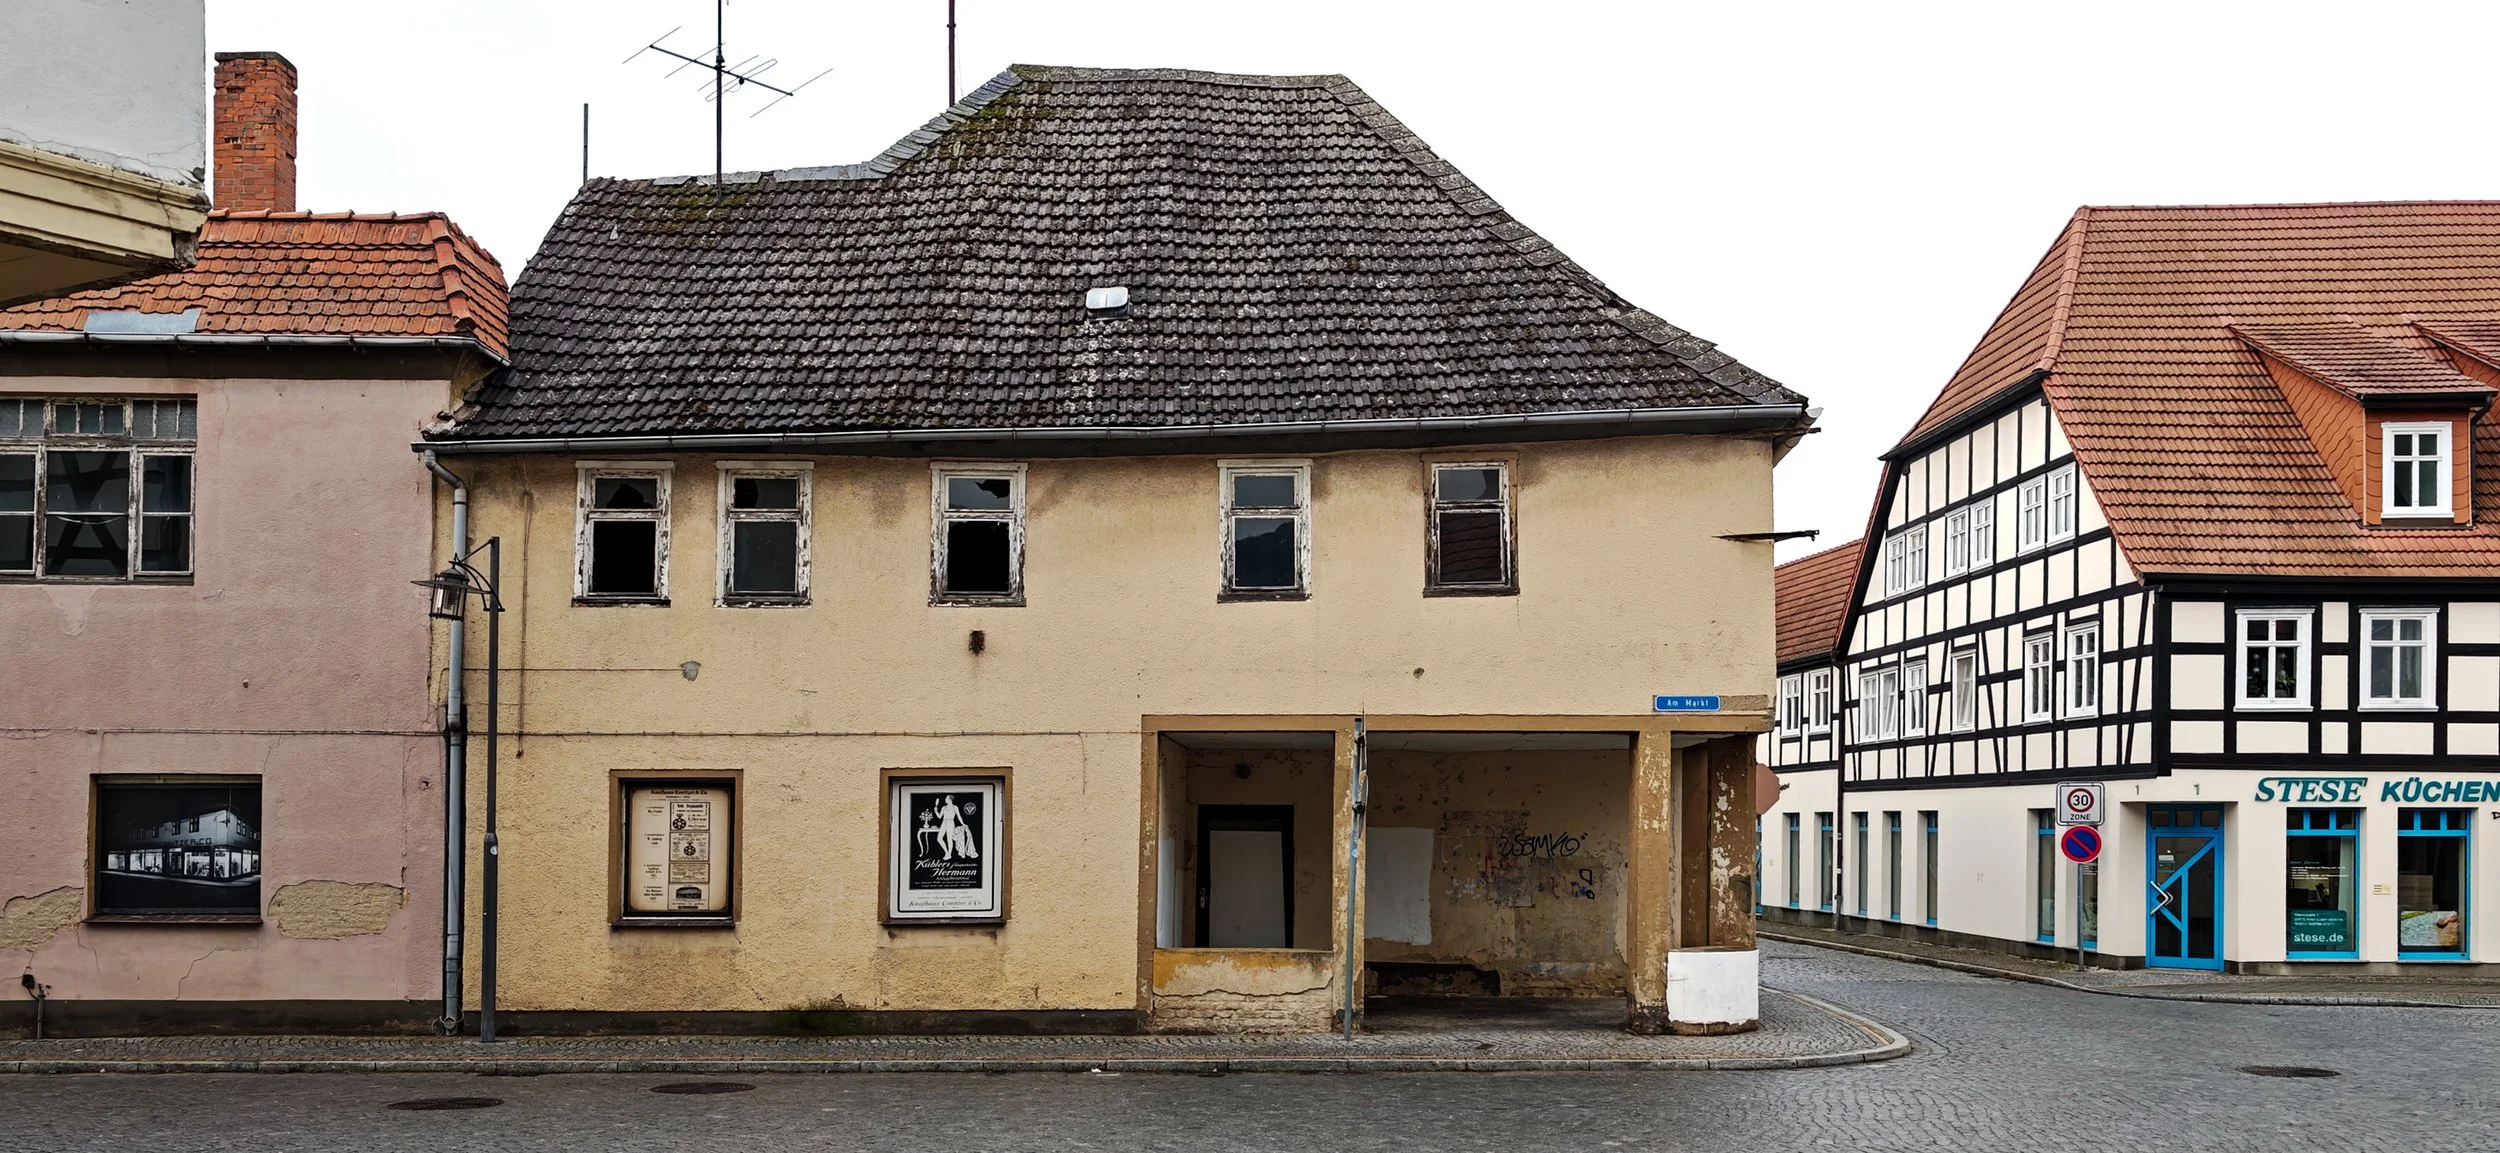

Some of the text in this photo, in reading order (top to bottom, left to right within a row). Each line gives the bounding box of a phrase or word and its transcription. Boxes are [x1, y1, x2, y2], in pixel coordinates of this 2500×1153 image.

[1667, 699, 1708, 707] Am Markt
[2194, 783, 2200, 796] 1
[2255, 777, 2500, 802] STESE KÜCHEN
[2072, 794, 2089, 806] 30
[2294, 933, 2344, 942] stese.de
